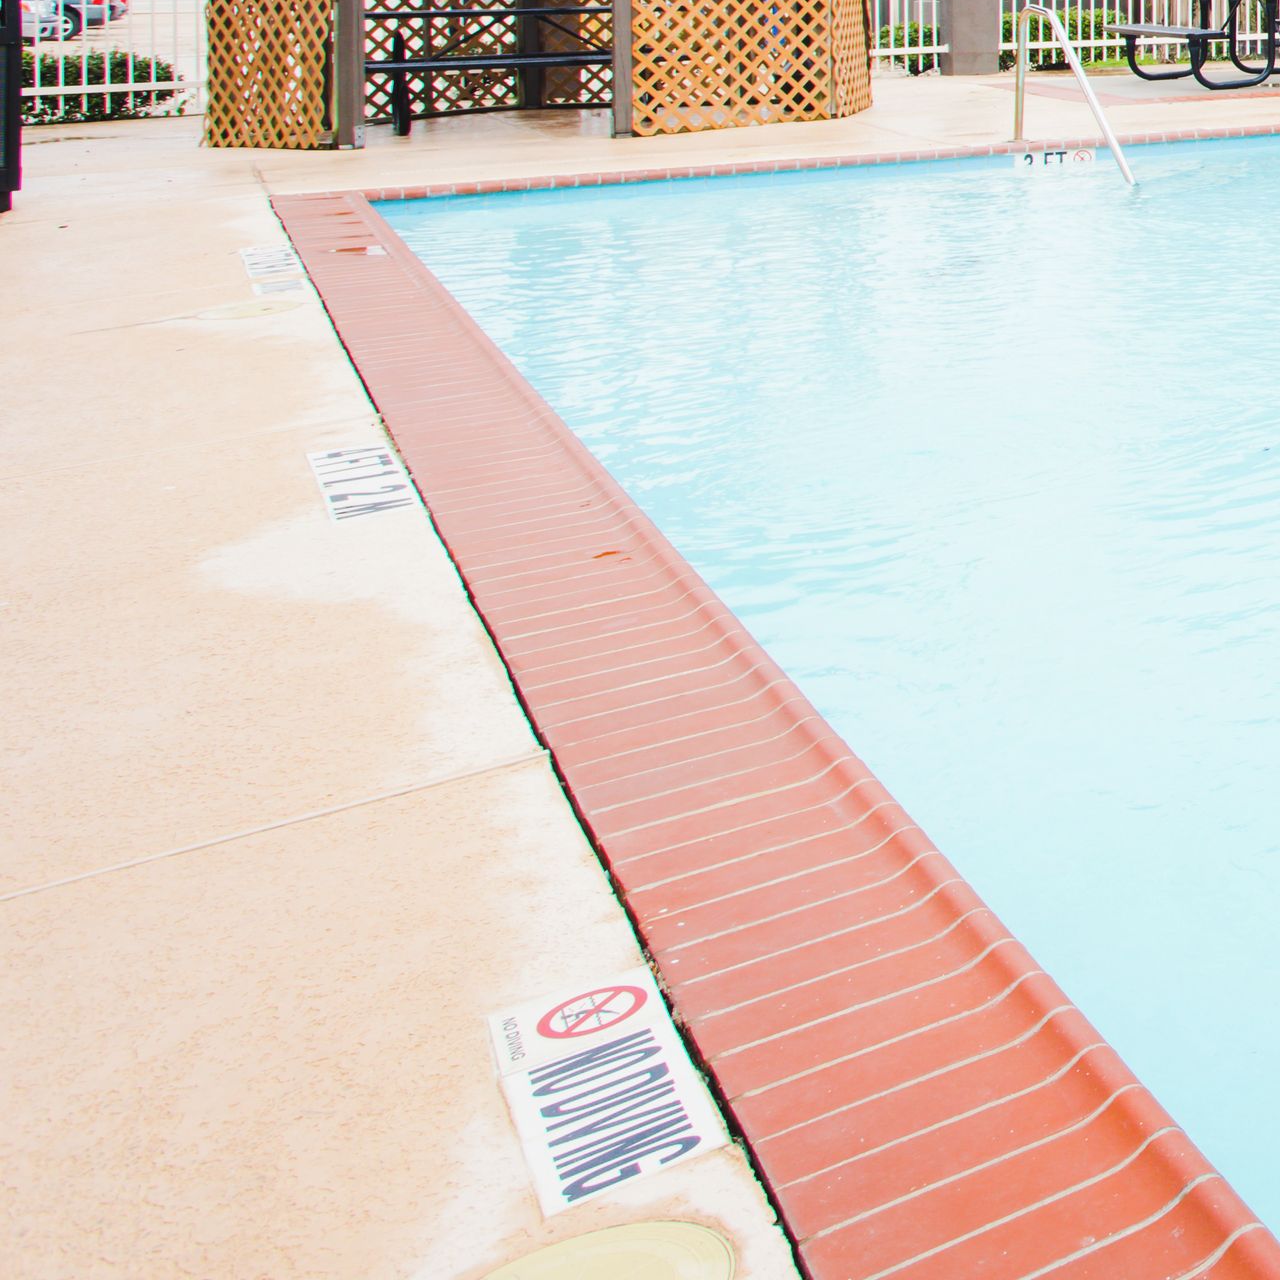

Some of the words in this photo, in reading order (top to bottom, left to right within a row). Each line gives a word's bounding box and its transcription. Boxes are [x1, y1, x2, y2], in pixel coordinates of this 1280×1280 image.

[503, 1016, 516, 1031] NO
[507, 1031, 526, 1062] DIVING
[528, 1028, 663, 1097] NO
[540, 1061, 702, 1203] DIVING
